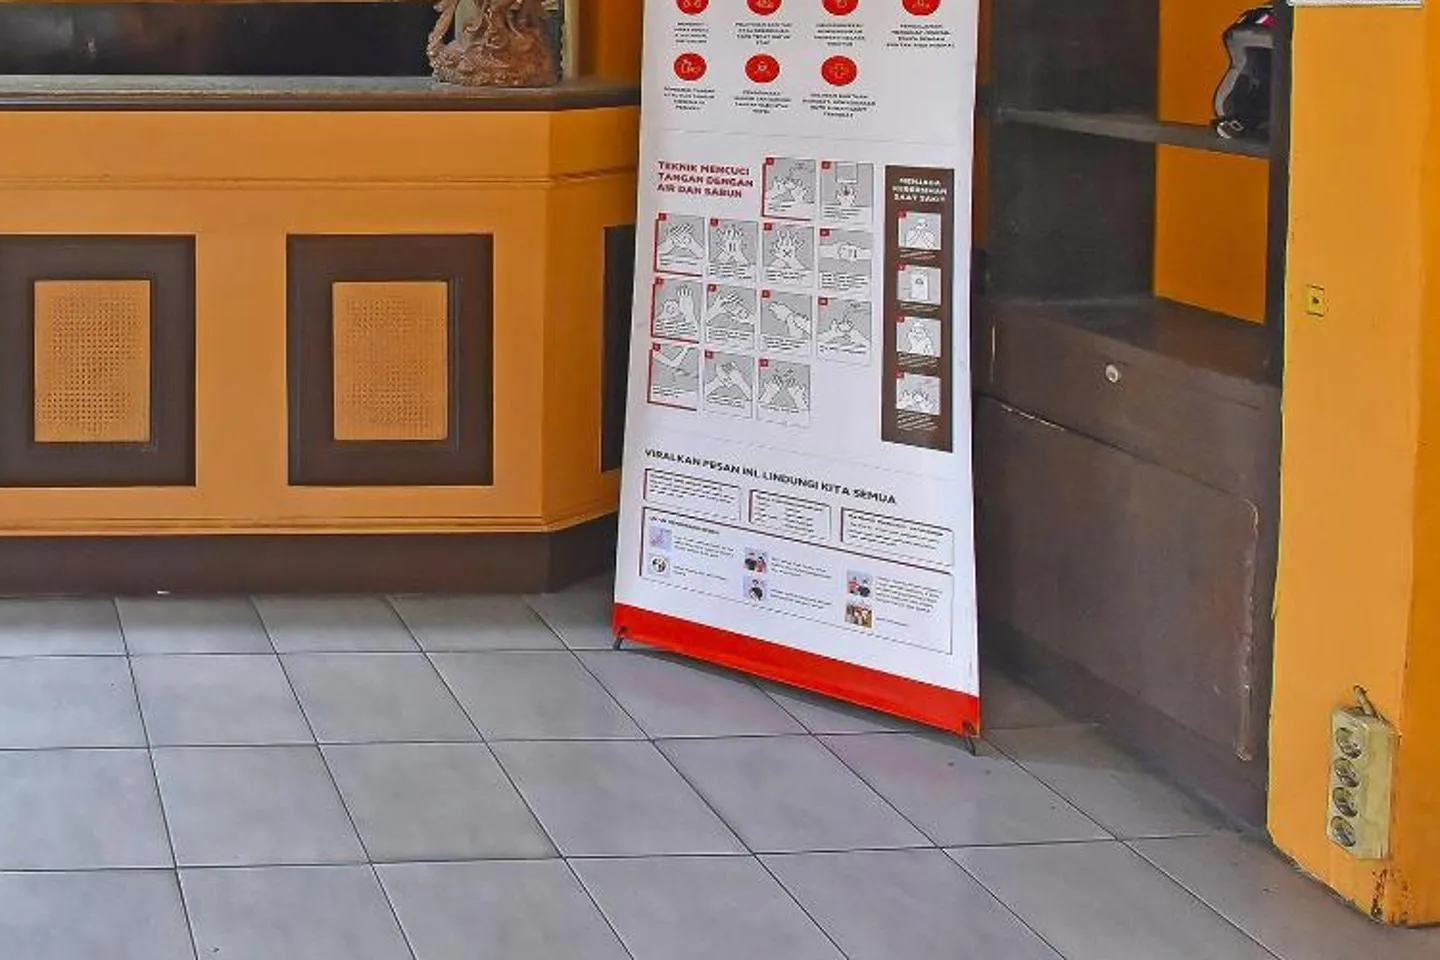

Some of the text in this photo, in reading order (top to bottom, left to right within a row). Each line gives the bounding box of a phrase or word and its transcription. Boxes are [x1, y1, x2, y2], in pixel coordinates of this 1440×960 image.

[658, 161, 698, 172] TEKNIK
[658, 172, 704, 184] TANGAN
[678, 186, 702, 195] DAN
[645, 448, 700, 466] VIRALKAN
[762, 471, 819, 490] LINDUNGI
[821, 481, 850, 496] KITA
[853, 489, 896, 504] SEMUA
